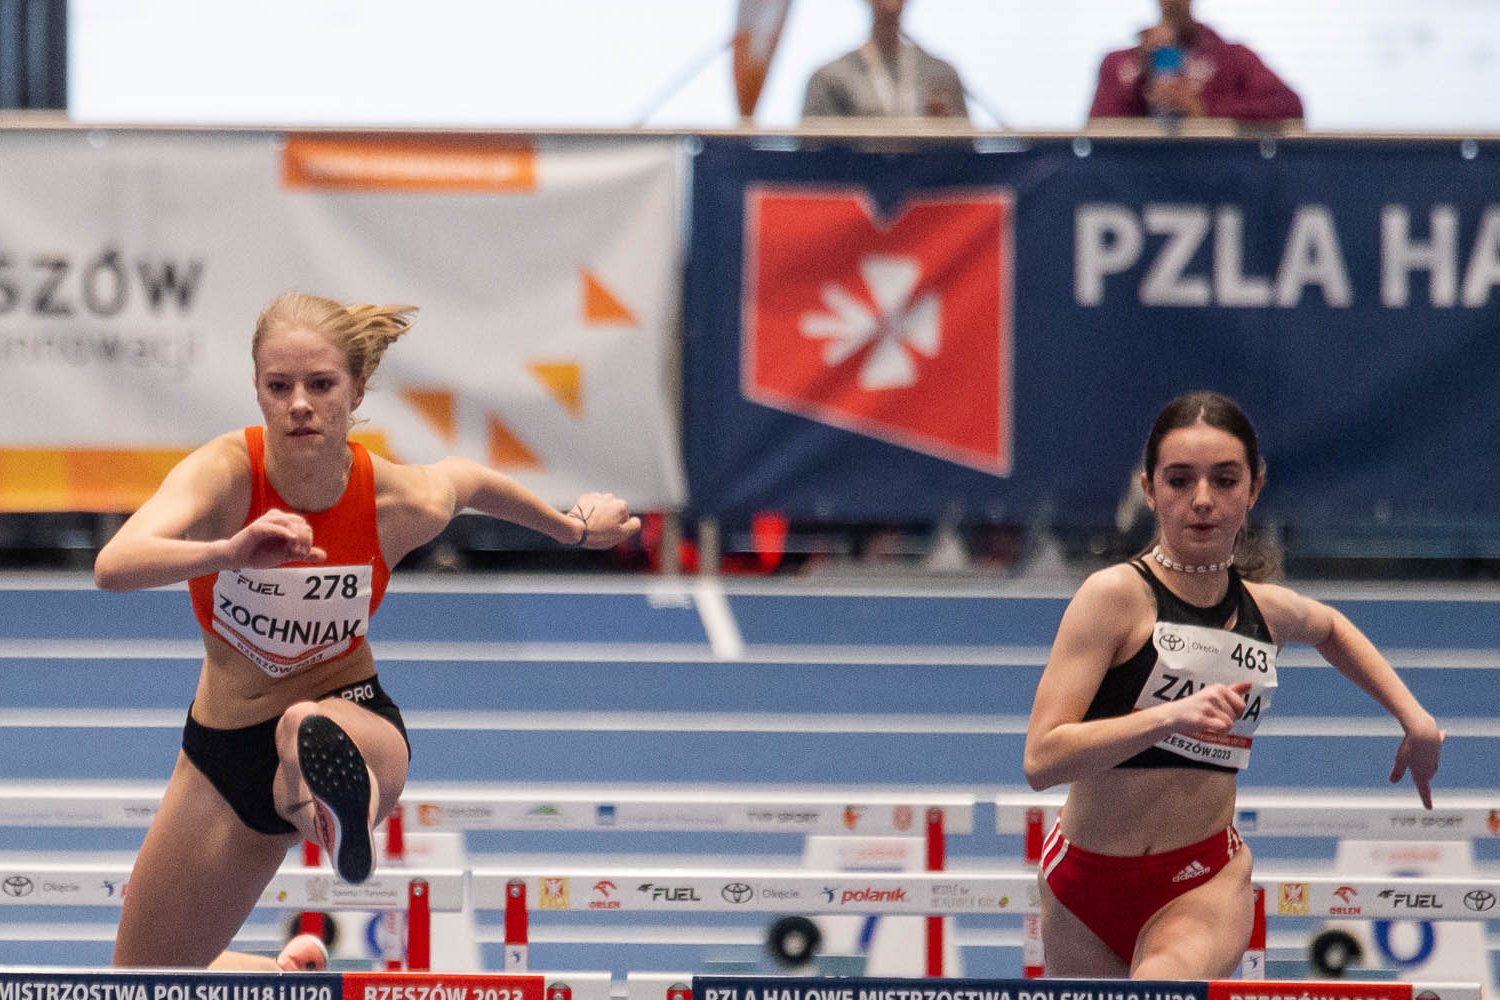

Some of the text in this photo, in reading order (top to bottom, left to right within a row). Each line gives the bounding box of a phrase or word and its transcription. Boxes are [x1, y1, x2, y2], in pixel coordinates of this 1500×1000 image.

[1075, 203, 1352, 308] PZLA
[237, 575, 285, 596] FUEL
[303, 574, 358, 600] 278
[219, 594, 361, 645] ZOCHNIAK
[1231, 643, 1268, 673] 463
[1163, 736, 1210, 756] ZESZÓW
[1172, 866, 1211, 882] adidas
[653, 888, 701, 901] FUEL
[840, 887, 907, 904] polanik
[1393, 894, 1443, 908] FUEL
[1329, 907, 1361, 915] ORLEN
